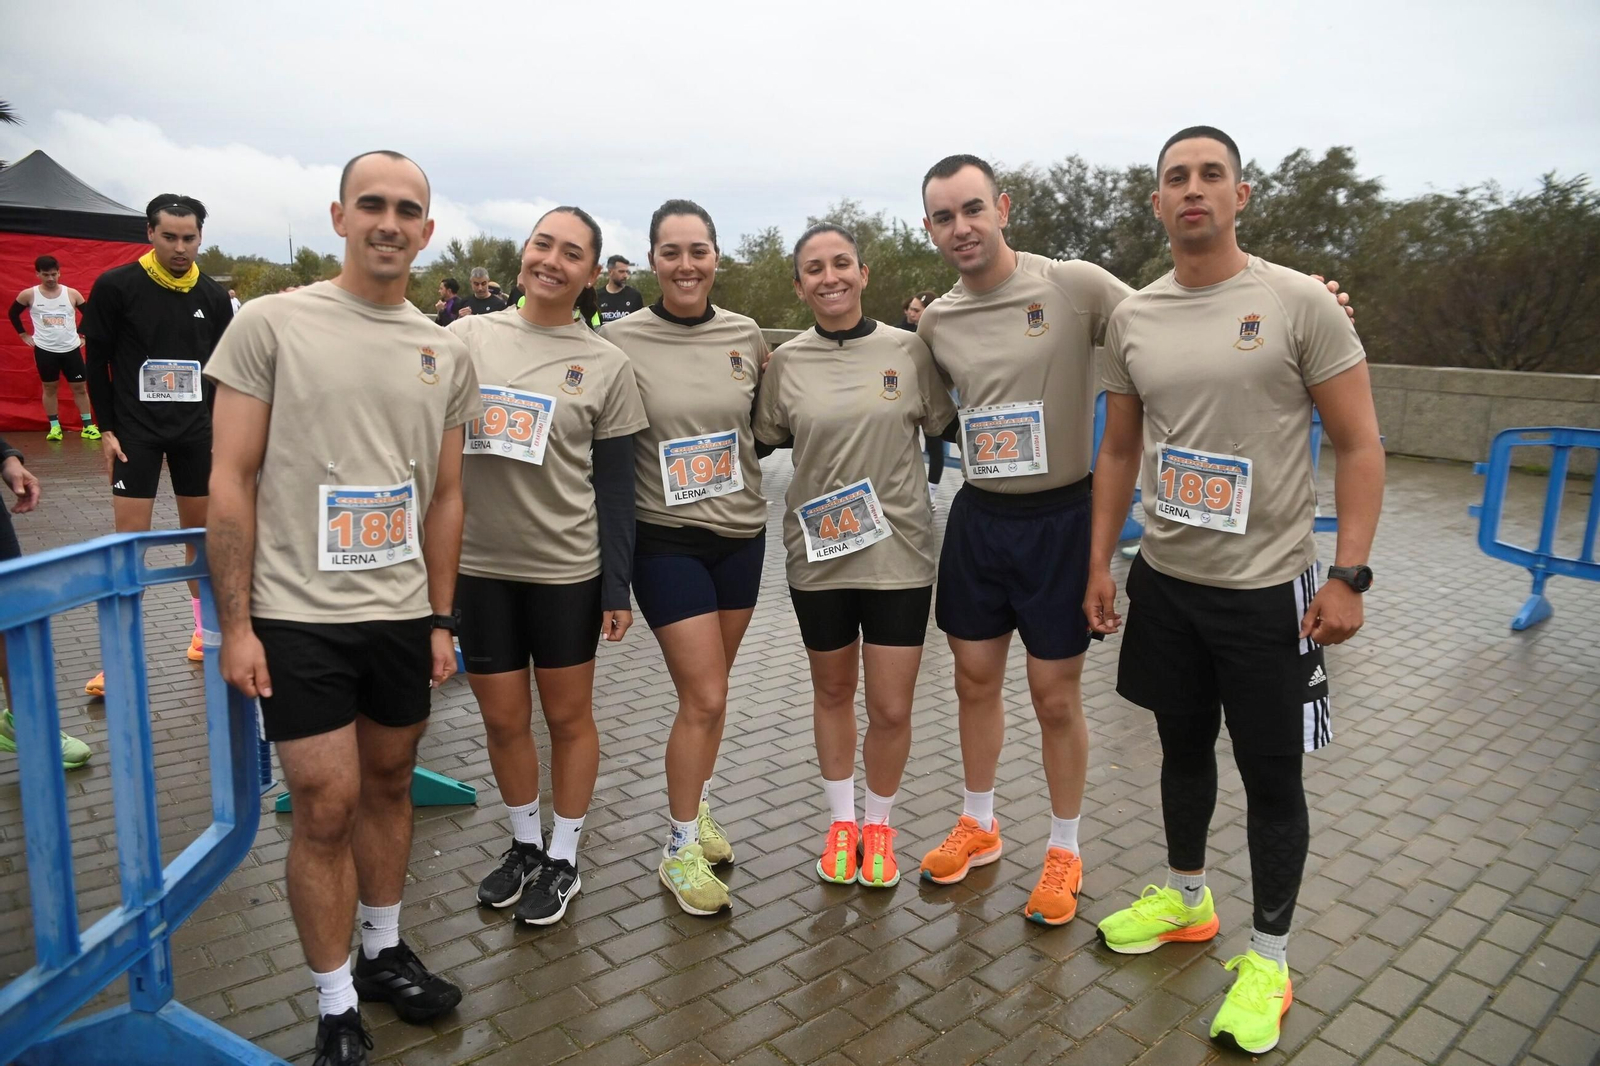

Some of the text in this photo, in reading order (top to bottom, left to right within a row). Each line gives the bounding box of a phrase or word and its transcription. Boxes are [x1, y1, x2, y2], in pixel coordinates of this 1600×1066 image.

[162, 372, 175, 390] 1
[975, 430, 1019, 462] 22
[669, 450, 731, 487] 194
[1161, 467, 1232, 511] 189
[329, 508, 405, 548] 188
[819, 507, 861, 540] 44
[1308, 674, 1326, 687] adidas
